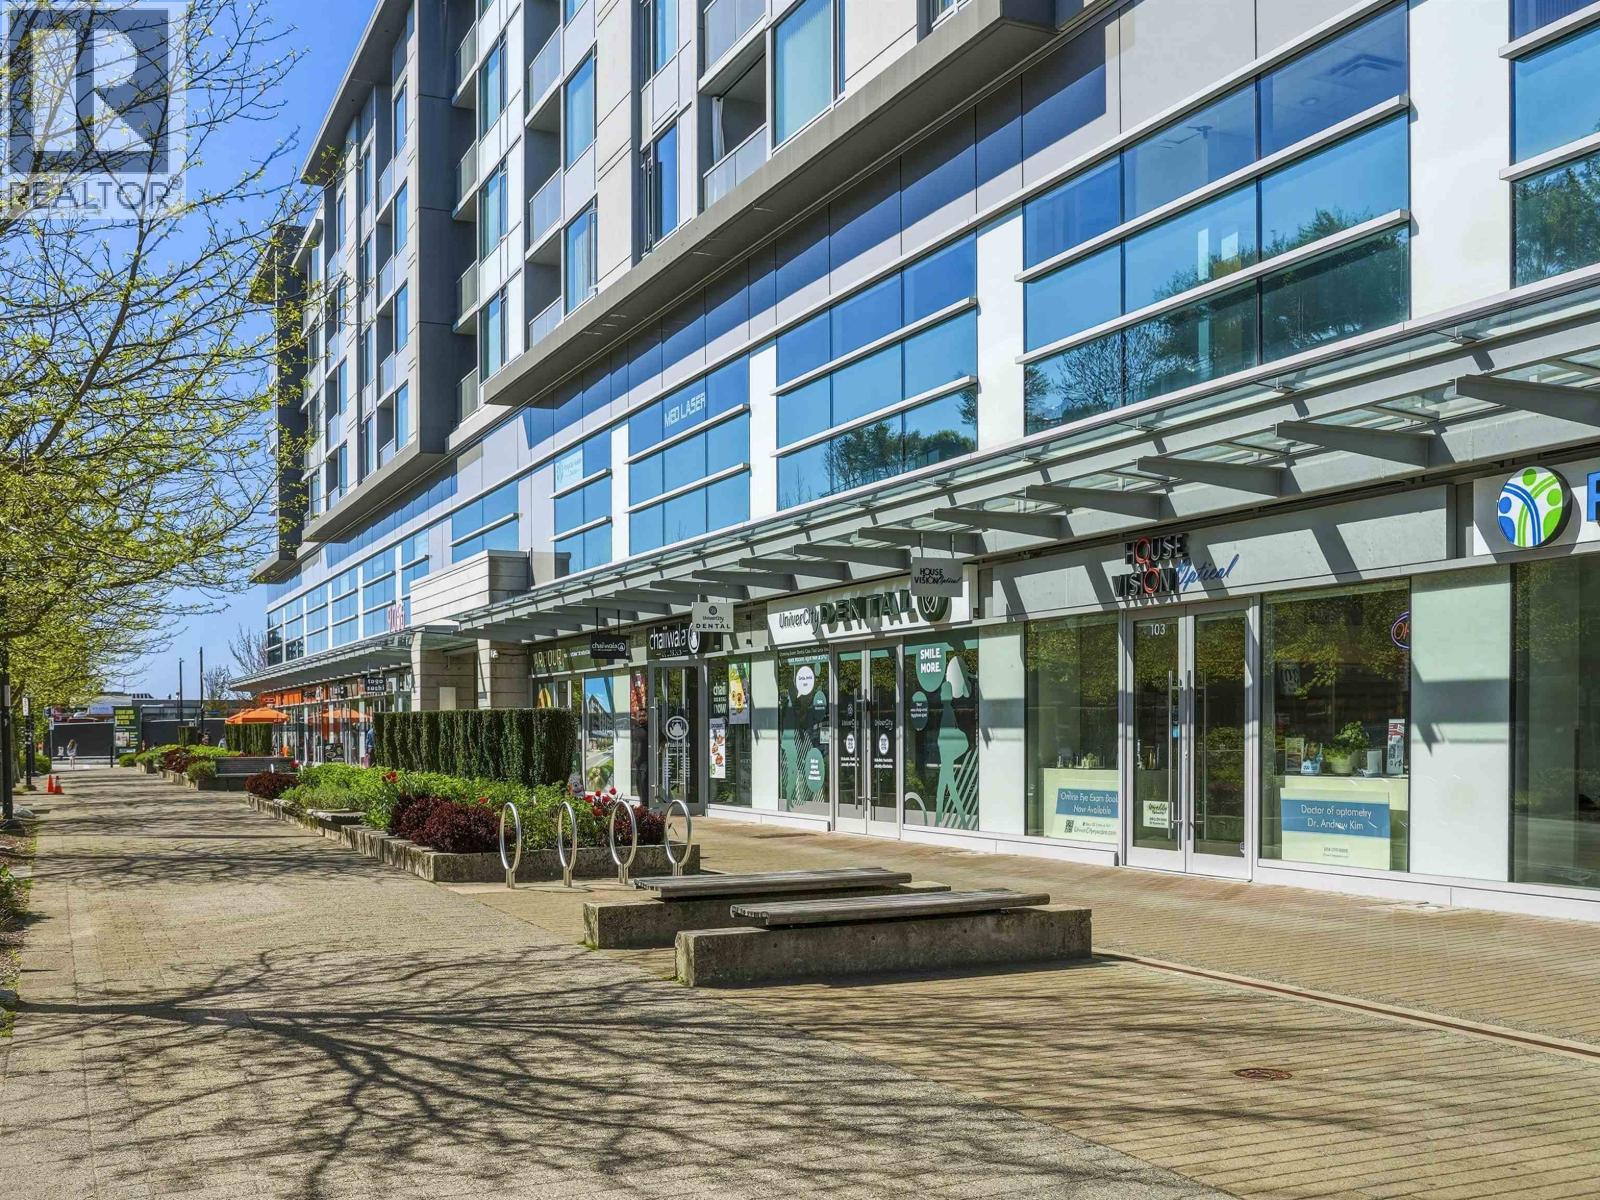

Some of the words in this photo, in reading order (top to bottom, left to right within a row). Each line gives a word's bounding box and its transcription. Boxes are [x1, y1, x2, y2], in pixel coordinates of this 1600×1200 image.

[664, 406, 680, 428] MED
[681, 391, 706, 419] LASER
[1125, 534, 1187, 564] HOUSE
[919, 567, 943, 576] HOUSE
[1112, 567, 1177, 597] VISION
[1177, 553, 1239, 591] Optical
[914, 576, 938, 584] VISION
[779, 608, 821, 635] UniverCity
[820, 589, 917, 624] DENTAL
[1151, 623, 1166, 636] 103
[1060, 791, 1079, 801] Online
[1080, 793, 1089, 803] Eye
[1073, 805, 1086, 813] Now
[1087, 805, 1112, 815] Available
[1301, 804, 1324, 815] Doctor
[1326, 805, 1335, 815] of
[1336, 808, 1372, 819] optometry
[1307, 818, 1320, 828] Dr.
[1321, 819, 1348, 830] Andrew
[1350, 820, 1364, 830] Kim
